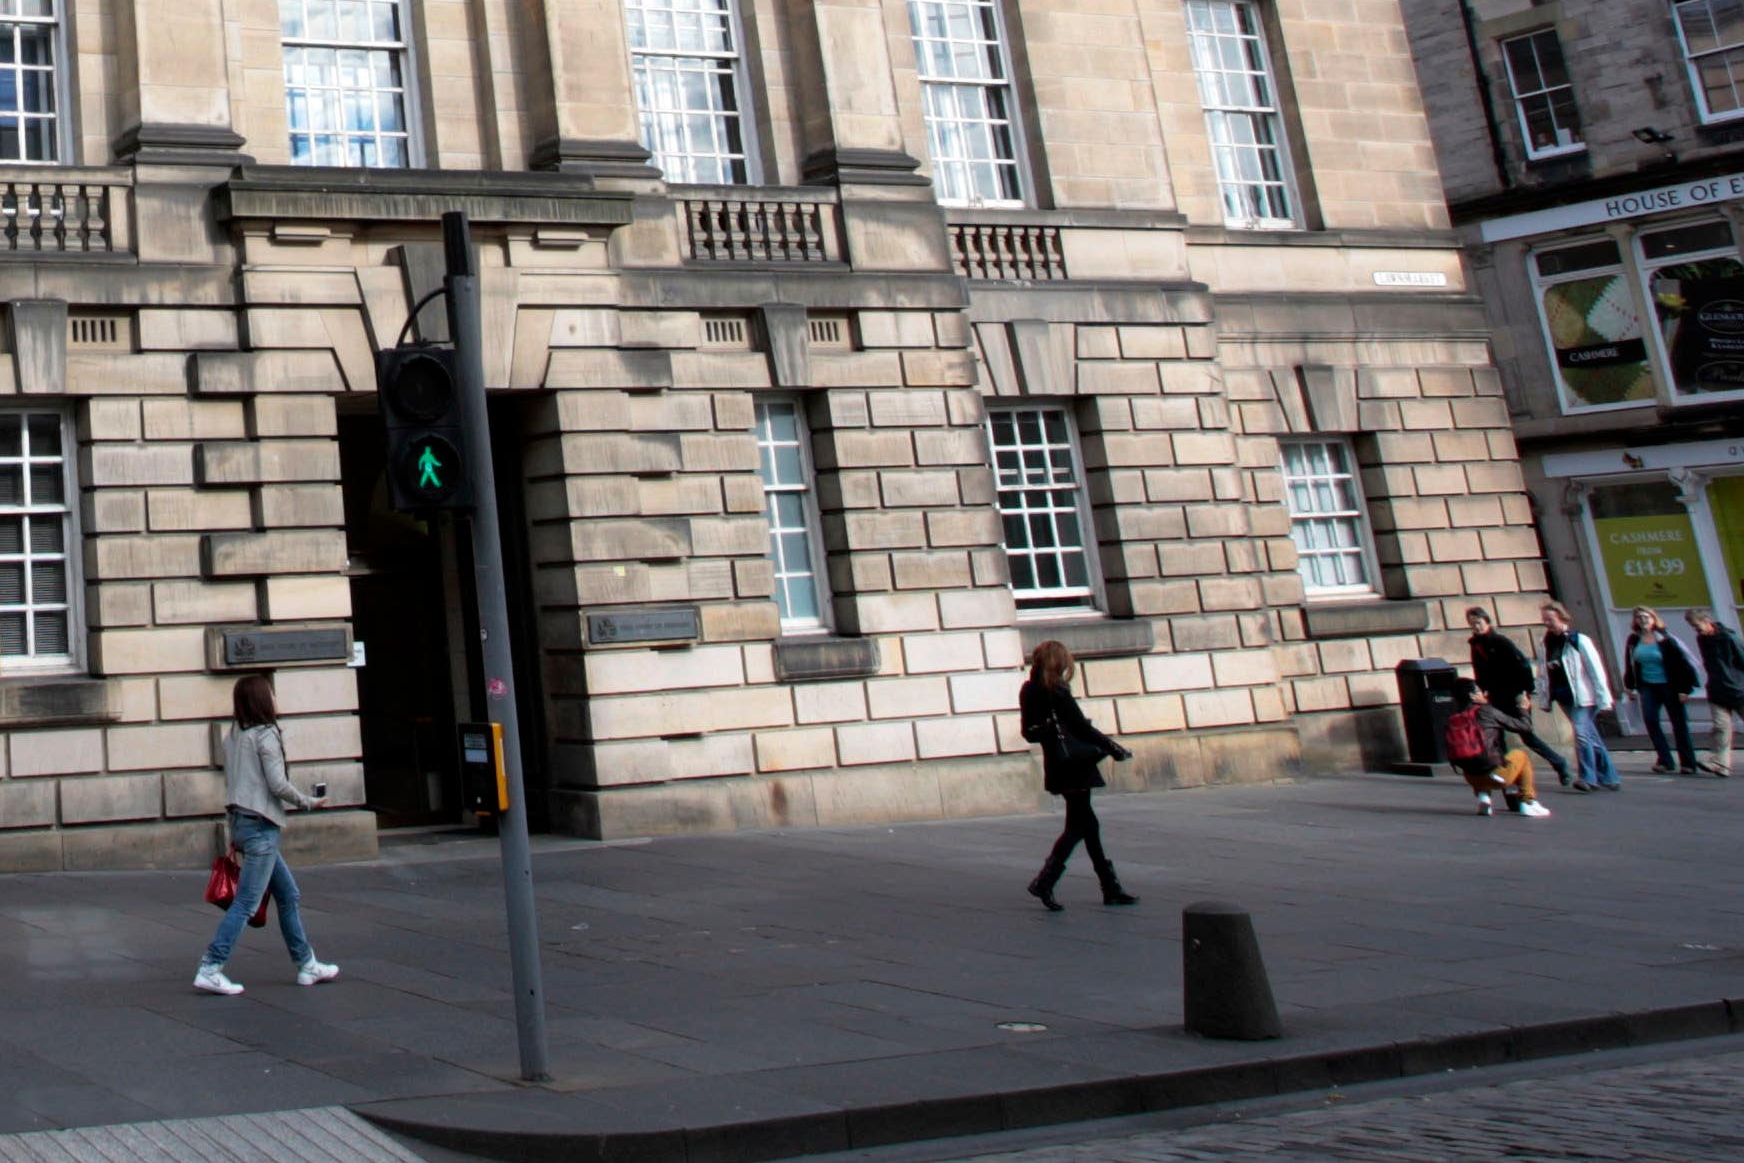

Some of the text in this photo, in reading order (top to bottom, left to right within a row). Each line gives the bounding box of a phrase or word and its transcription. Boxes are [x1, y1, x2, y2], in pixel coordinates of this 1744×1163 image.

[1606, 177, 1744, 216] HOUSE OF E
[1569, 348, 1619, 362] CASHMERE
[1609, 530, 1683, 545] CASHMERE
[1623, 558, 1685, 577] £14.99
